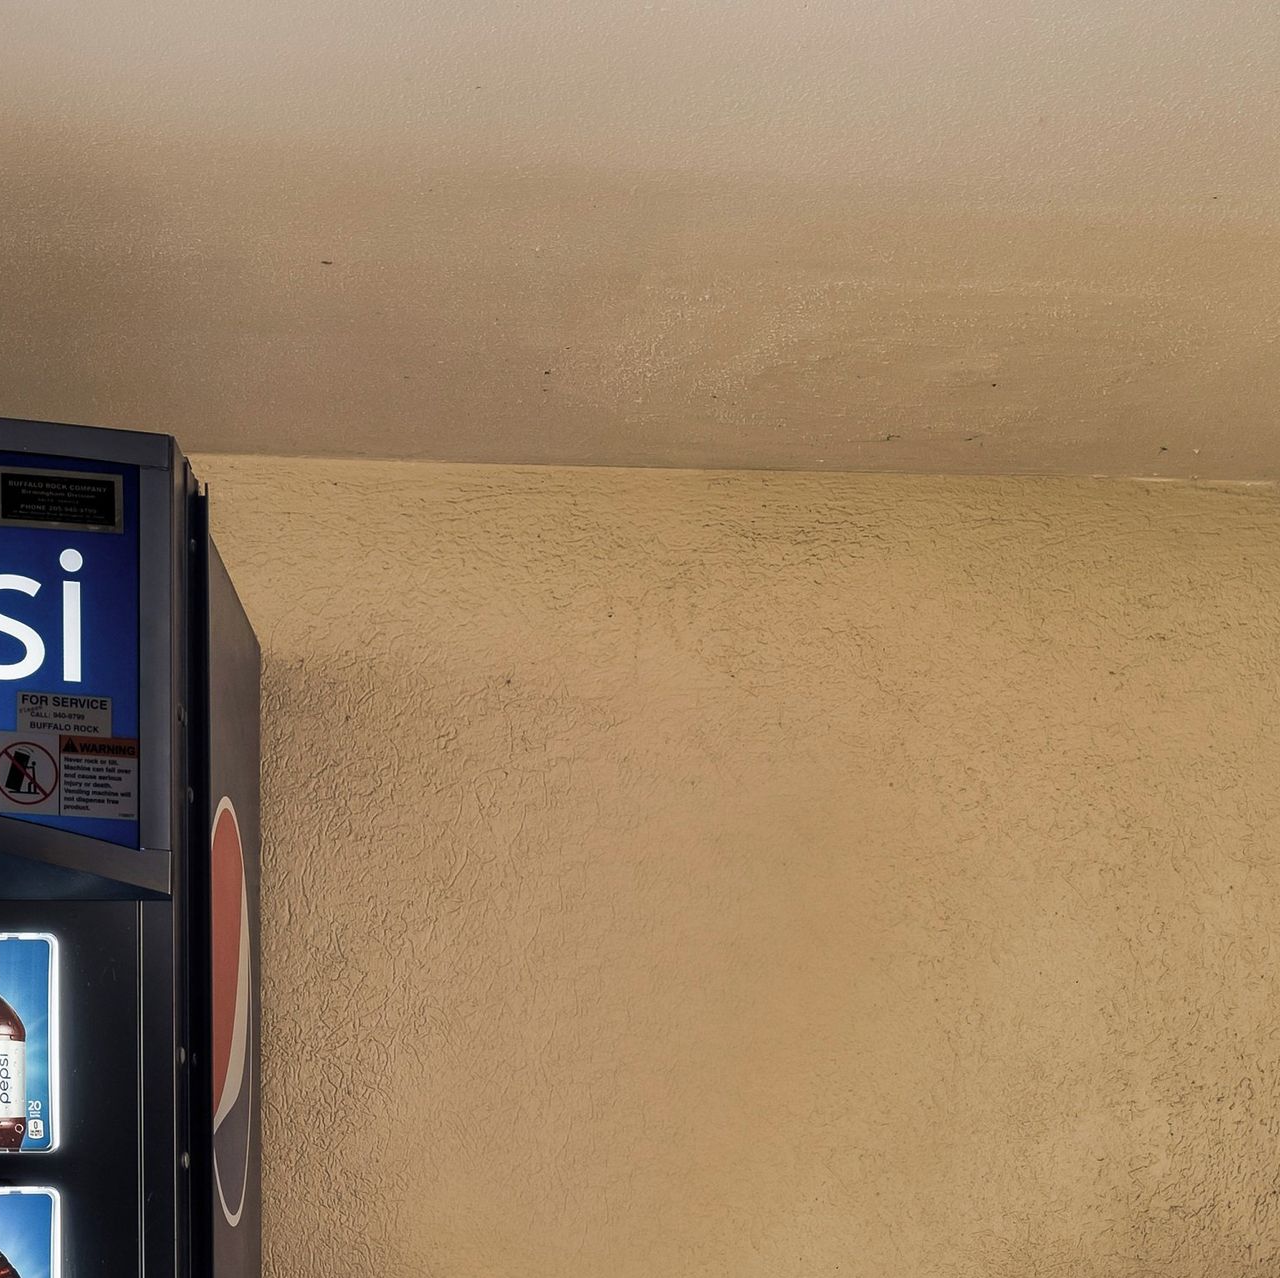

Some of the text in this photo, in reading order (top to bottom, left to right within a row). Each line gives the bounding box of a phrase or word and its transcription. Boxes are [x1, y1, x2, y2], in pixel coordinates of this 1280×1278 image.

[8, 480, 43, 488] BUFFALO
[70, 484, 106, 493] COMPANY
[22, 694, 48, 706] FOR
[53, 696, 107, 710] SERVICE
[30, 721, 99, 733] BUFFALO ROCK
[80, 743, 135, 755] WARNING
[28, 1100, 41, 1110] 20
[34, 1121, 38, 1129] 0
